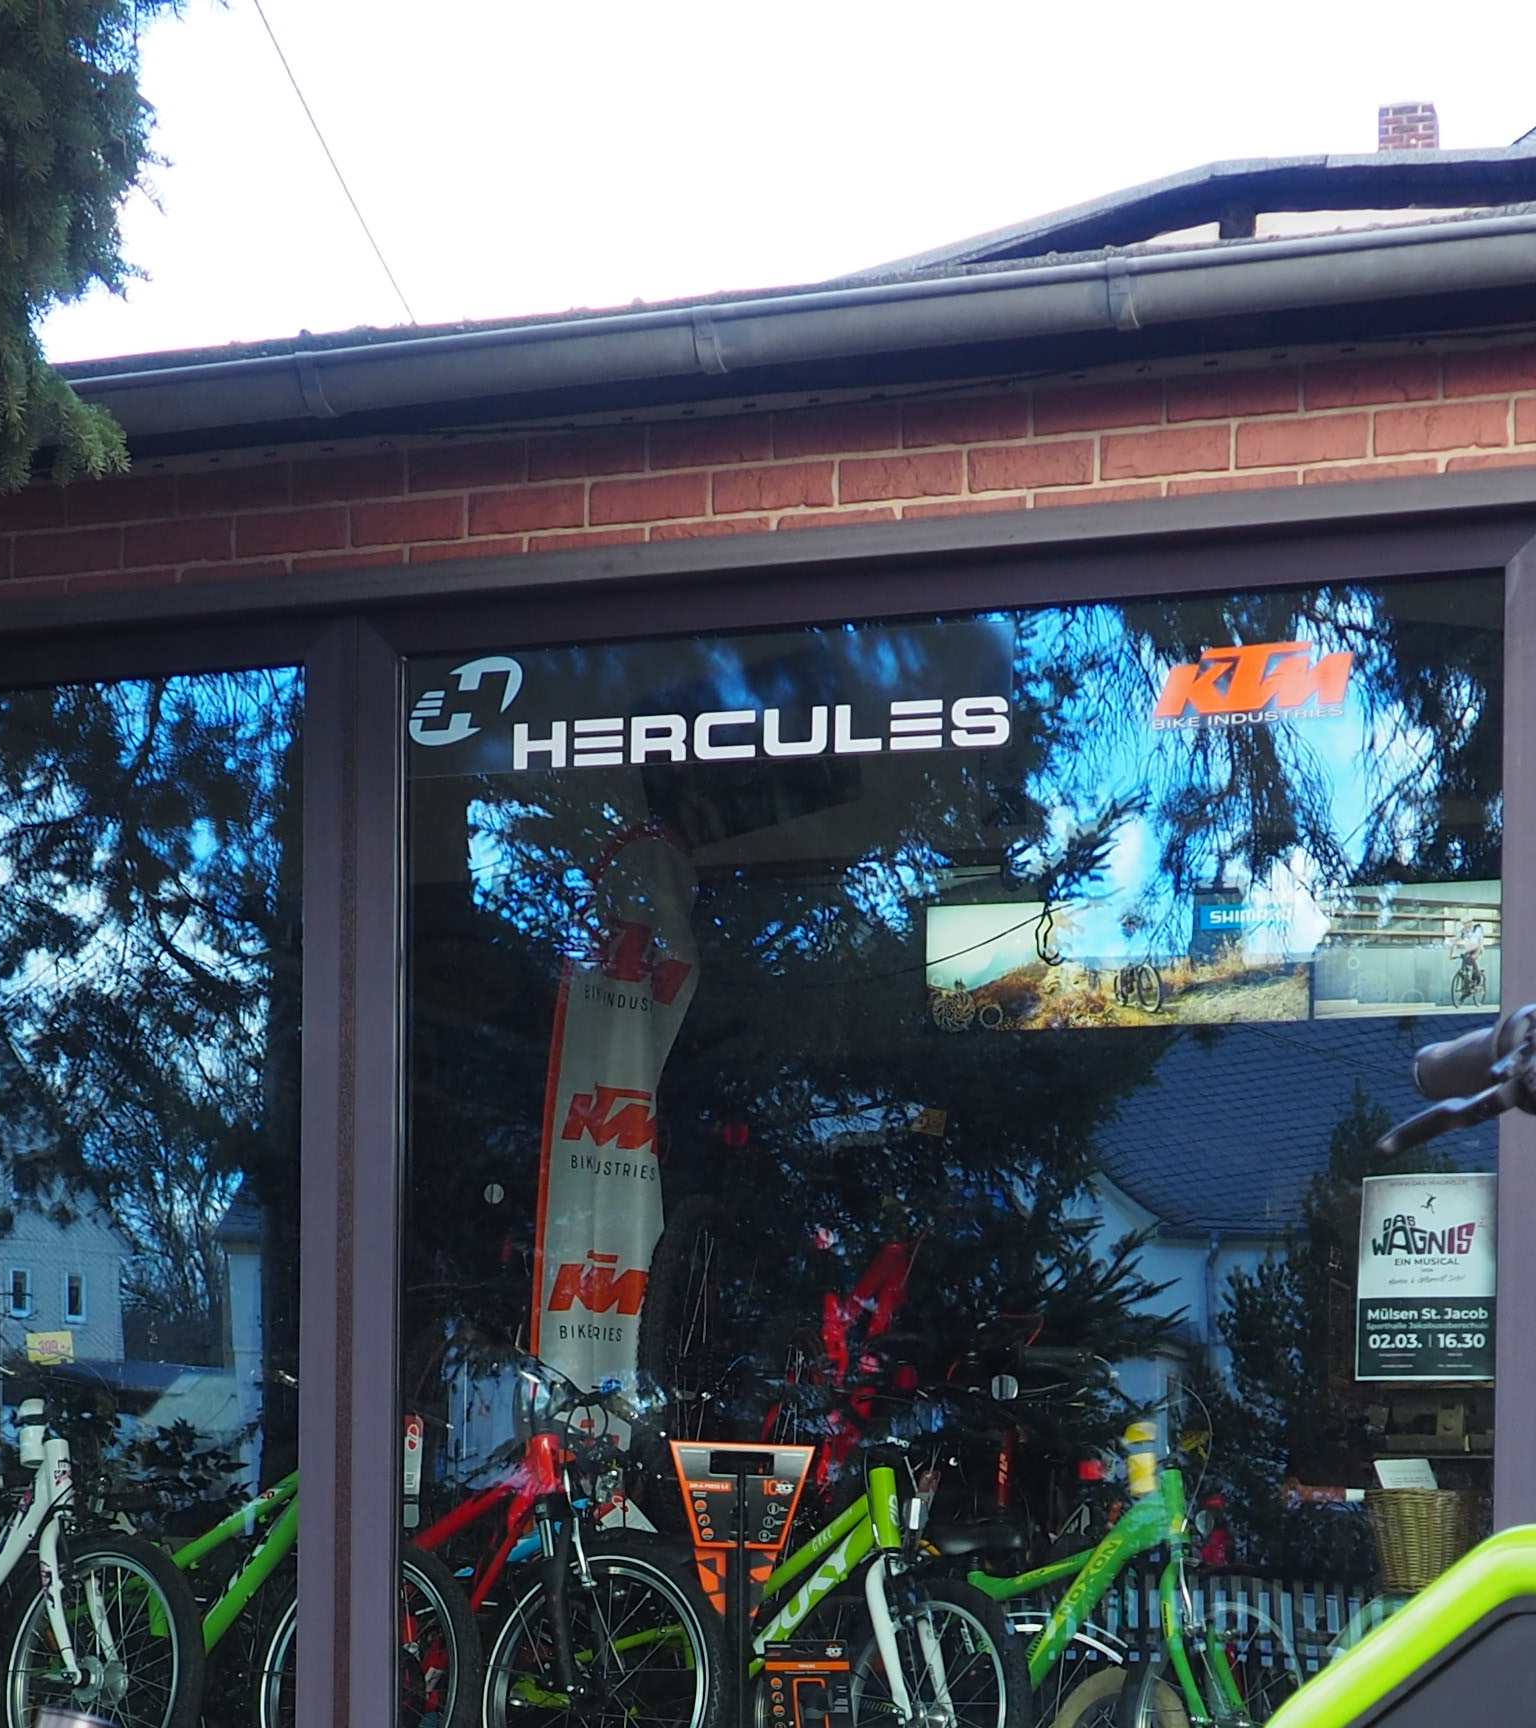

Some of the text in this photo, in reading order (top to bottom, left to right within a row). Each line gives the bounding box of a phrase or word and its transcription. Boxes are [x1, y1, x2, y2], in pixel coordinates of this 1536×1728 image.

[1154, 641, 1354, 718] KTM
[1152, 707, 1344, 730] BIKE INDUSTRIES
[513, 696, 1010, 770] HERCULES
[1383, 1214, 1416, 1233] DAS
[1371, 1221, 1477, 1256] WAGNIS
[1394, 1257, 1461, 1266] EIN MUSICAL
[1367, 1307, 1489, 1320] Mülsen St. Jacob
[1368, 1332, 1486, 1350] 02.03. 16.30
